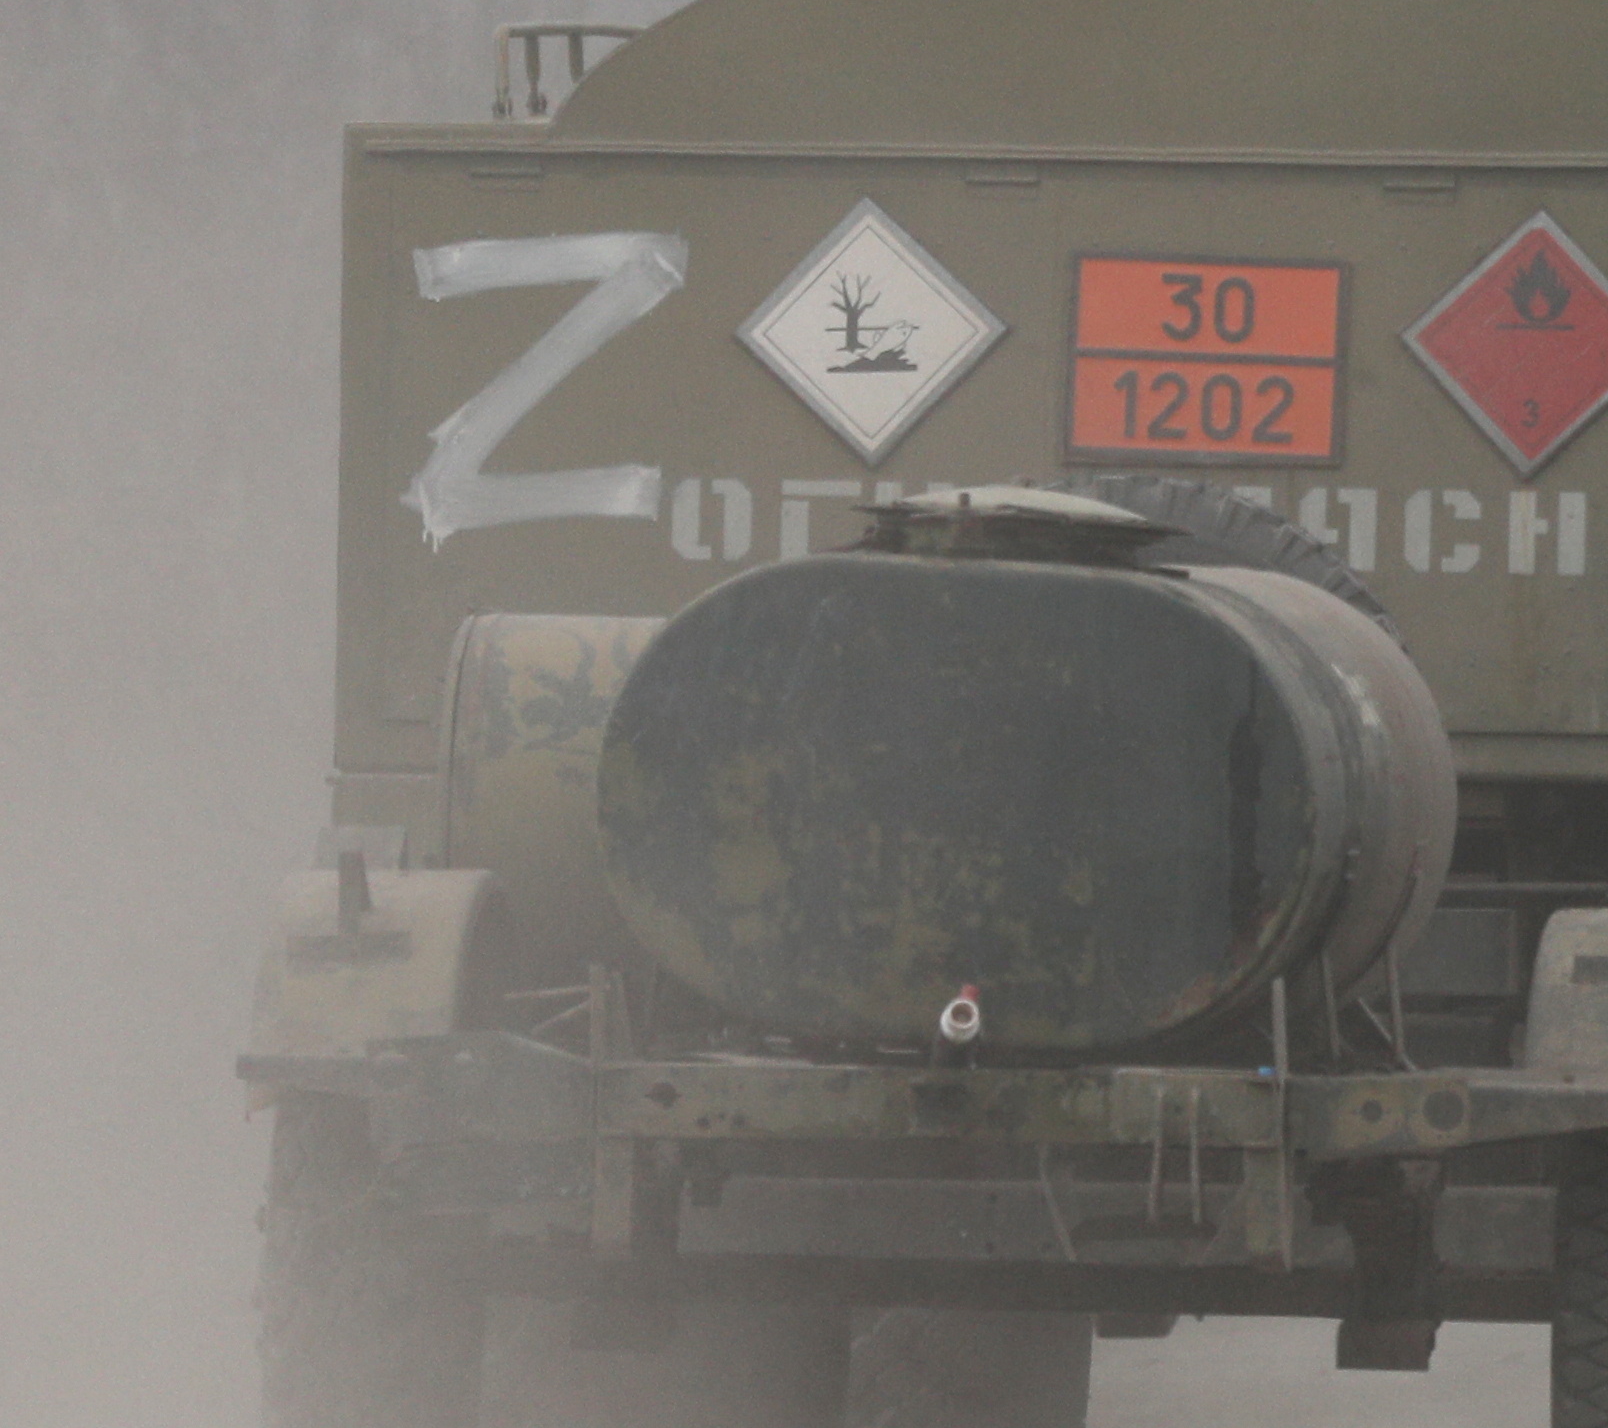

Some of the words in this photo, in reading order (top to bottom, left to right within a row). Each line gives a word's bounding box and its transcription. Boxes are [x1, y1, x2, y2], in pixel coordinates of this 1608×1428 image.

[1160, 273, 1257, 344] 30
[402, 230, 689, 553] Z
[1113, 370, 1295, 445] 1202
[1521, 398, 1541, 429] 3
